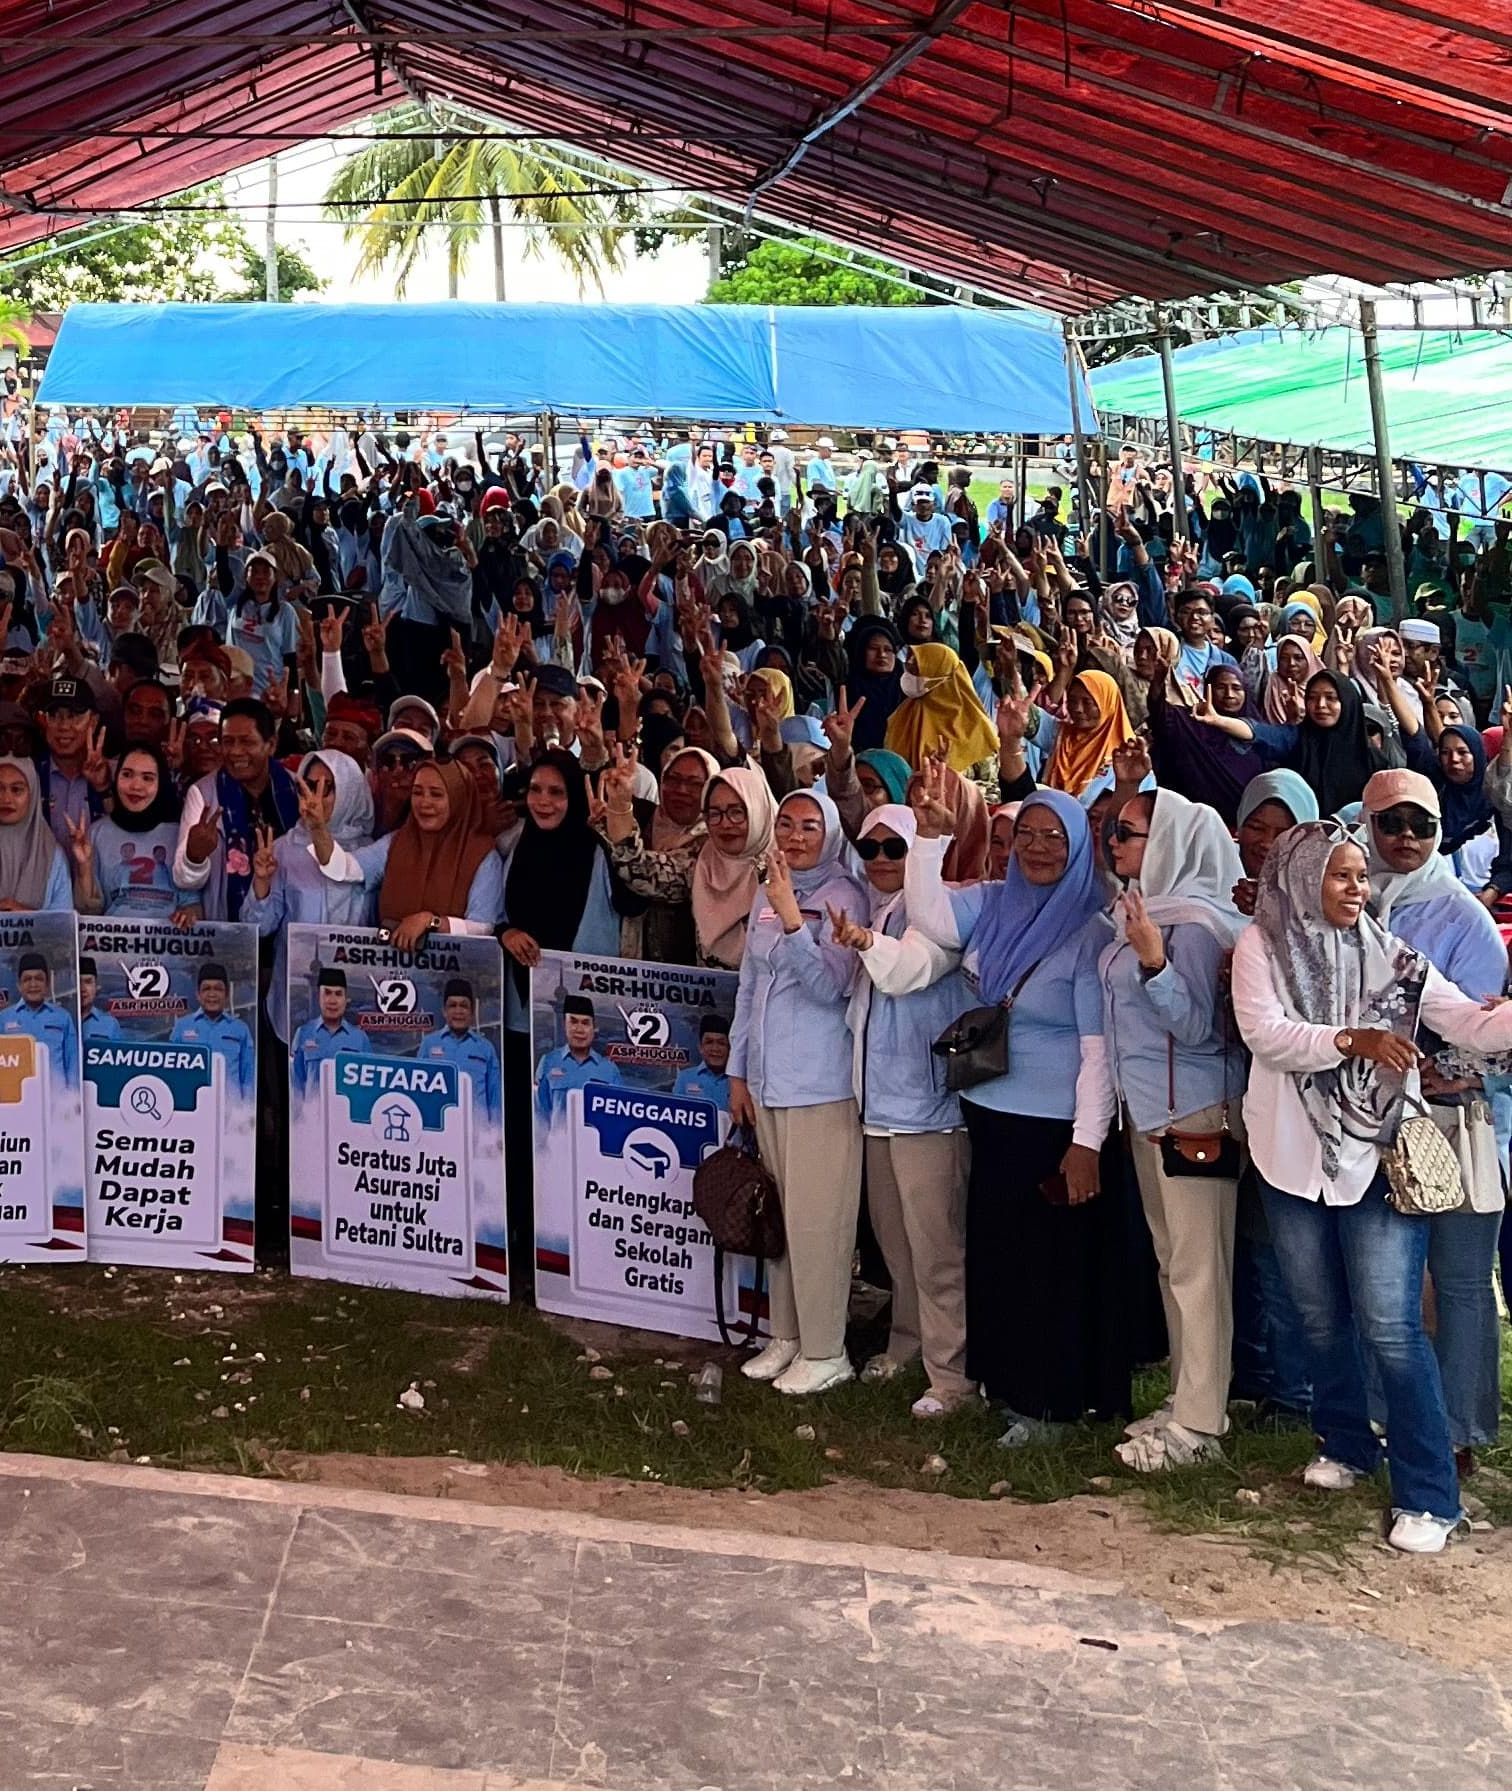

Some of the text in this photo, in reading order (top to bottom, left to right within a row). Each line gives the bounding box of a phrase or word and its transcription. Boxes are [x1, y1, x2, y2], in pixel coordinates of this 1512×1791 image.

[79, 923, 140, 934] PROGRAM
[329, 933, 381, 945] PROGRA
[82, 935, 215, 957] ASR-HUGUA
[333, 946, 460, 972] ASR-HUGUA
[139, 969, 161, 998] 2
[574, 960, 716, 987] PROGRAM UNGGULAN
[112, 1000, 183, 1011] ASR-HUGUA
[387, 982, 409, 1012] 2
[579, 974, 716, 1008] ASR-HUGUA
[362, 1014, 430, 1025] ASR-HUGUA
[638, 1015, 661, 1045] 2
[87, 1048, 205, 1070] SAMUDERA
[611, 1047, 685, 1060] ASR-HUGUA
[343, 1062, 448, 1095] SETARA
[591, 1096, 707, 1128] PENGGARIS
[95, 1129, 195, 1154] Semua
[94, 1154, 195, 1180] Mudah
[338, 1142, 457, 1178] Seratus Juta
[99, 1180, 191, 1208] Dapat
[354, 1170, 441, 1202] Asuransi
[585, 1180, 696, 1220] Perlengkap
[105, 1205, 183, 1234] Kerja
[370, 1201, 428, 1226] untuk
[588, 1208, 716, 1246] dan Seragam
[335, 1217, 463, 1256] Petani Sultra
[614, 1238, 693, 1269] Sekolah
[624, 1266, 684, 1295] Gratis
